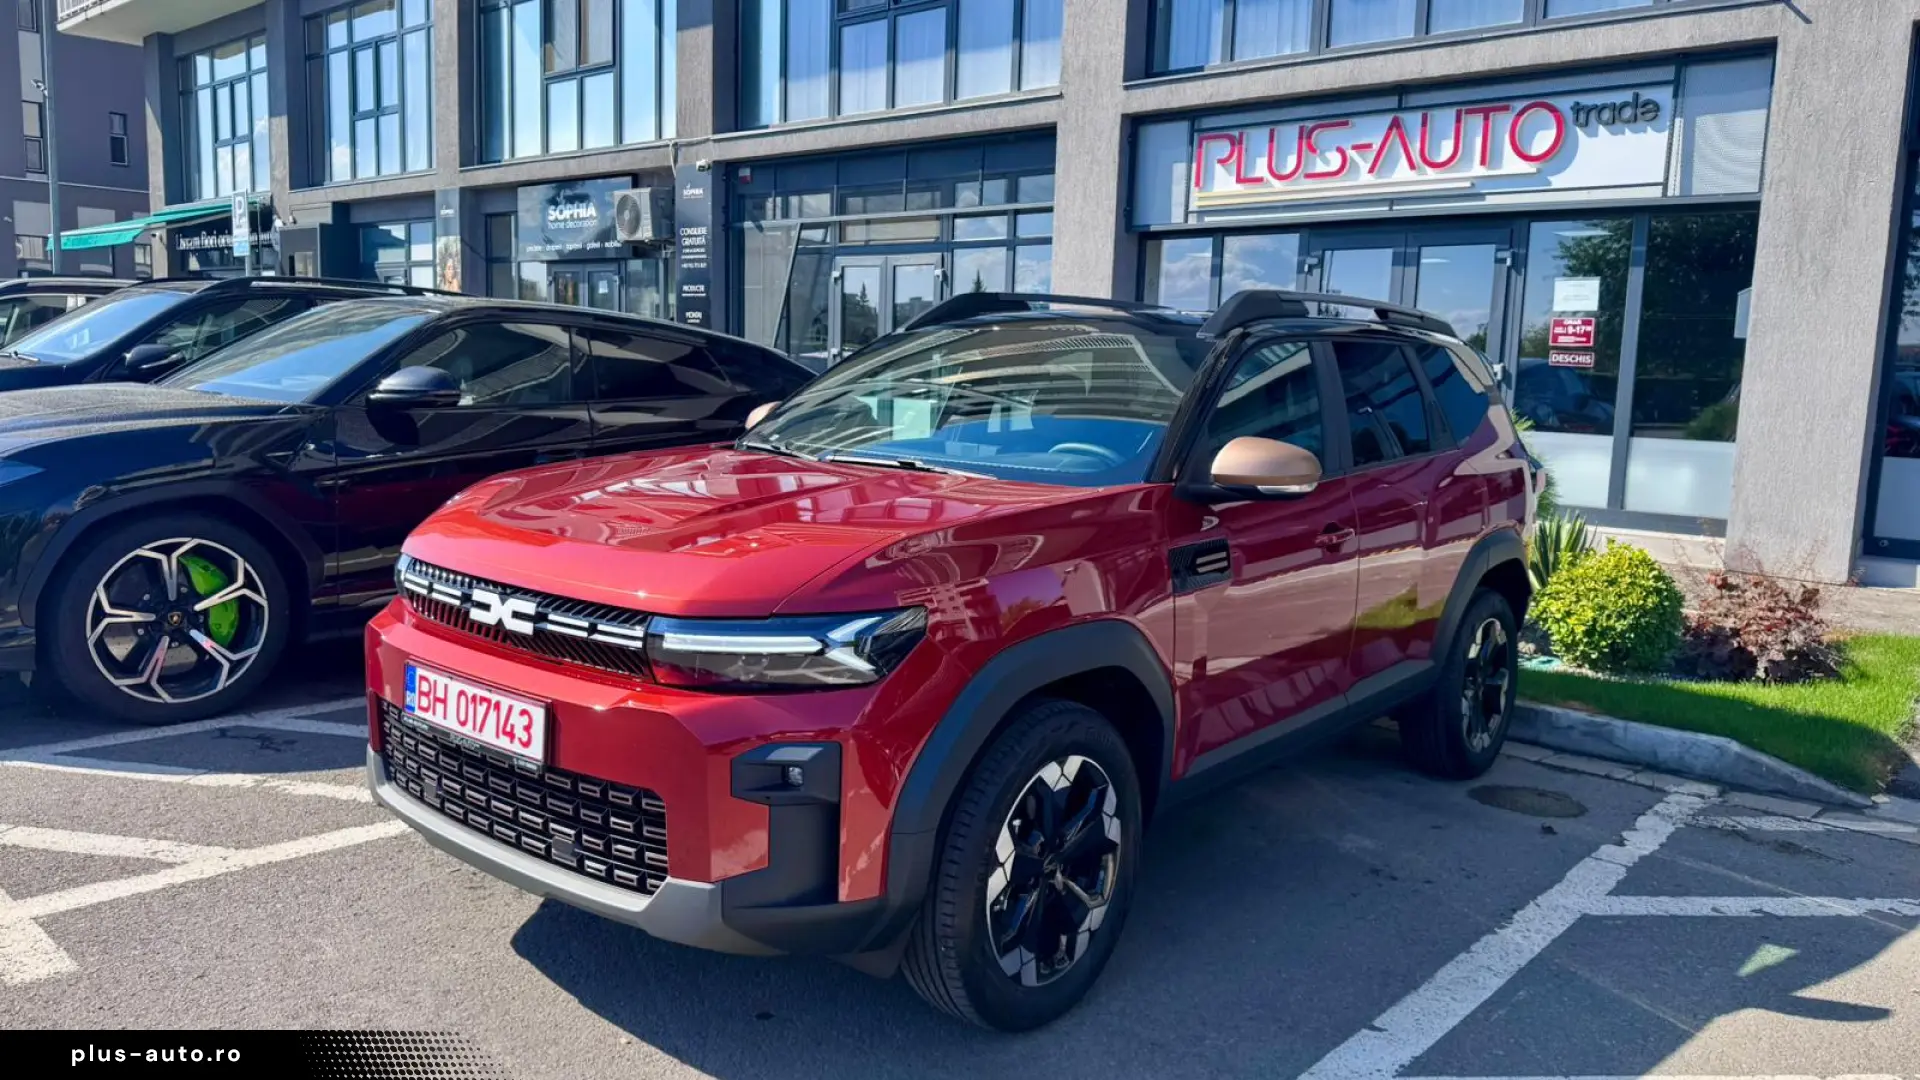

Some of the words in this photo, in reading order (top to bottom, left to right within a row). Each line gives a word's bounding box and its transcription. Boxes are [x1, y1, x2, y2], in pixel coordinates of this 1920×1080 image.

[1570, 91, 1661, 127] trade
[1194, 100, 1567, 189] PLUS-AUTO
[547, 202, 597, 221] SOPHIA
[1552, 354, 1591, 364] DESCHIS
[417, 674, 449, 721] BH
[456, 689, 534, 749] 017143
